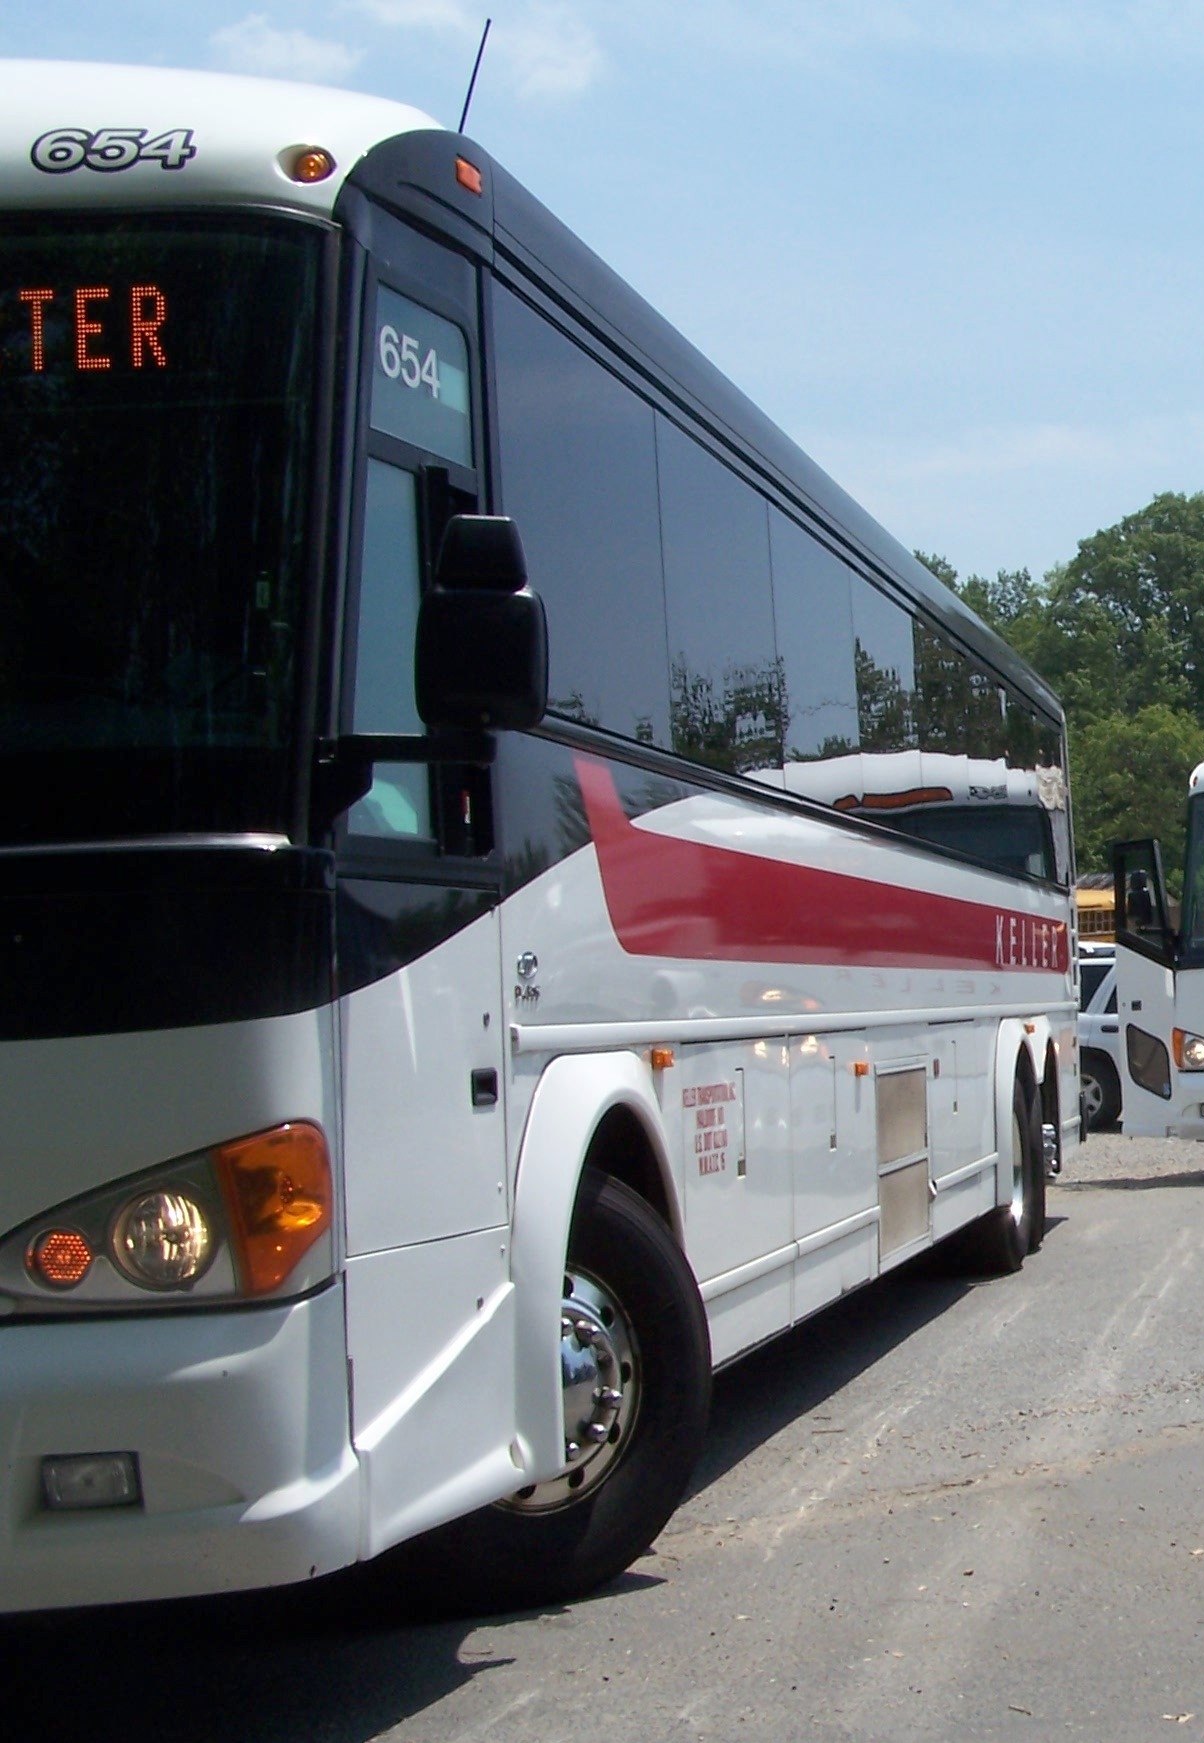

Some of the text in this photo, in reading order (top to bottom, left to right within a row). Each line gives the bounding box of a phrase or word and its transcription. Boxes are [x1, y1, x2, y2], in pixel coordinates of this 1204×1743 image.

[31, 128, 196, 174] 654
[19, 284, 168, 373] TER
[380, 324, 441, 399] 654
[995, 914, 1059, 969] KELLER
